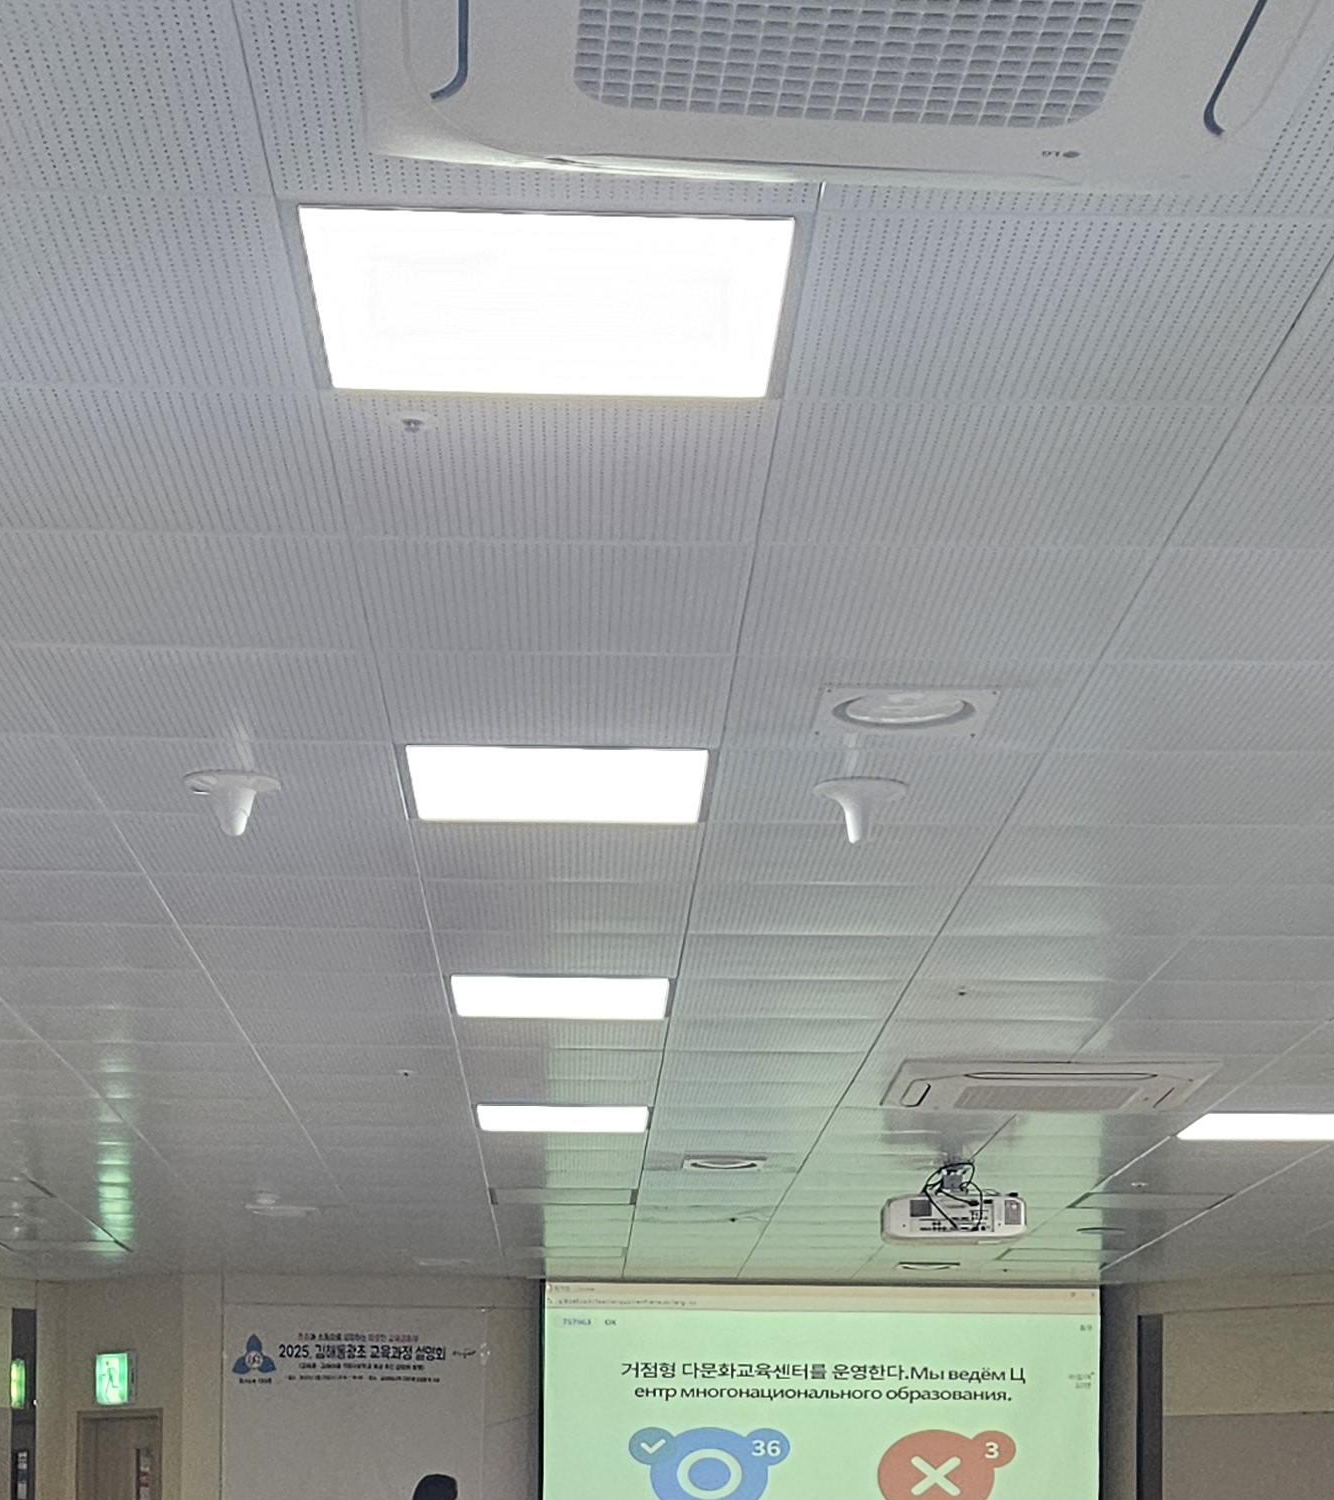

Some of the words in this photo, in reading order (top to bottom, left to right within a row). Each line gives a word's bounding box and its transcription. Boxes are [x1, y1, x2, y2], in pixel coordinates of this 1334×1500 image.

[370, 1345, 413, 1360] 교육과정
[415, 1346, 446, 1361] 설명회
[621, 1362, 676, 1379] 거점형
[682, 1363, 828, 1380] 다문화교육센터를
[948, 1368, 1006, 1383] ведём
[634, 1387, 677, 1401] ентр
[680, 1388, 882, 1401] многонационального
[886, 1386, 1012, 1403] образования.
[751, 1440, 781, 1457] 36
[984, 1442, 1000, 1459] 3
